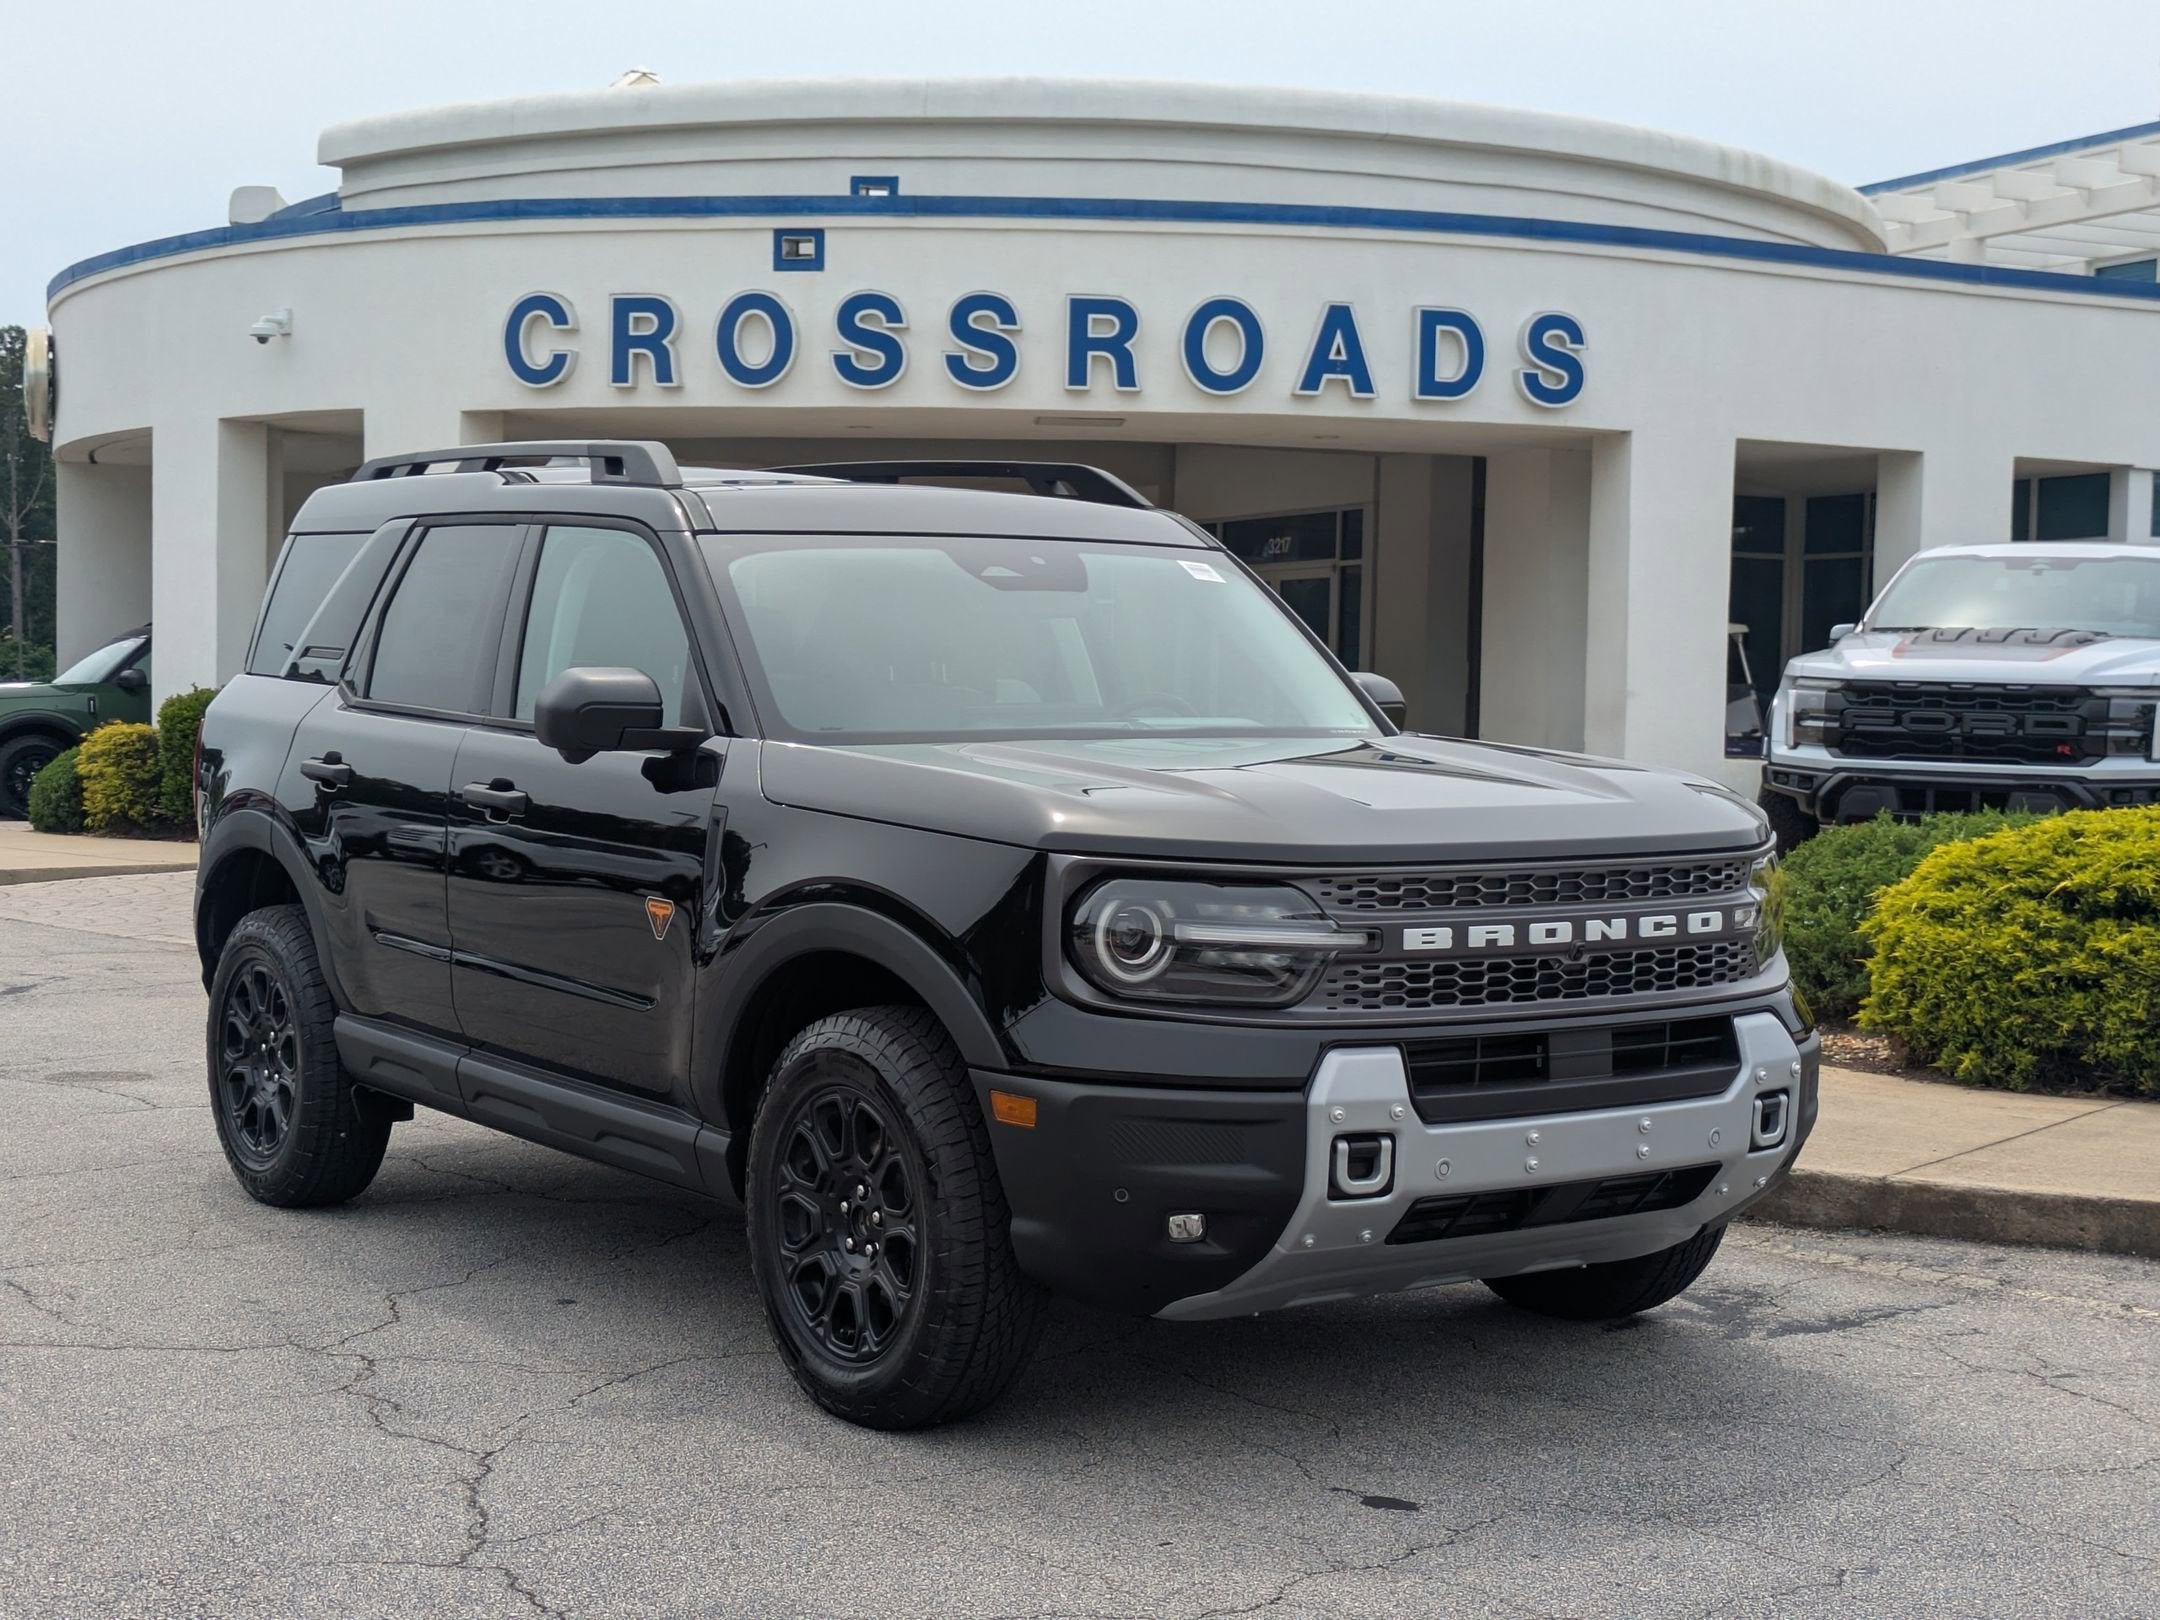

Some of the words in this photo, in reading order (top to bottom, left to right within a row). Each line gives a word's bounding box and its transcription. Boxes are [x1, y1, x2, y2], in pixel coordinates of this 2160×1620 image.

[503, 291, 1586, 407] CROSSROADS
[1267, 537, 1292, 554] 3217
[1842, 708, 2086, 736] FORD
[1403, 911, 1723, 950] BRONCO
